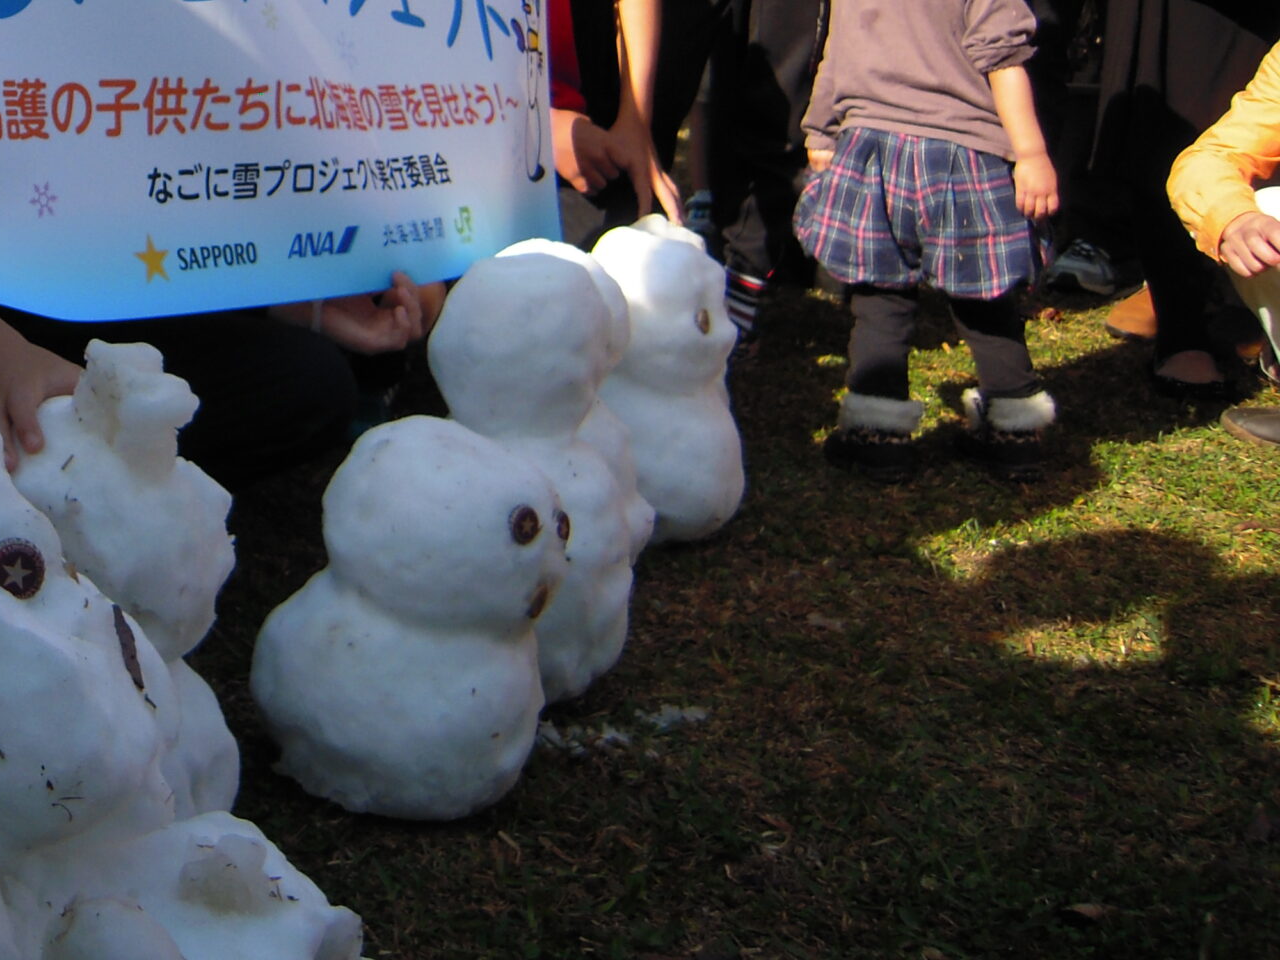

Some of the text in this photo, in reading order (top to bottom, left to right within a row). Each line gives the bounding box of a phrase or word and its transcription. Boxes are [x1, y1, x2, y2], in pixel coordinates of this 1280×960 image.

[147, 152, 452, 204] なごに雪プロジェクト実行委員会
[176, 241, 258, 271] SAPPORO
[287, 230, 335, 260] ANA
